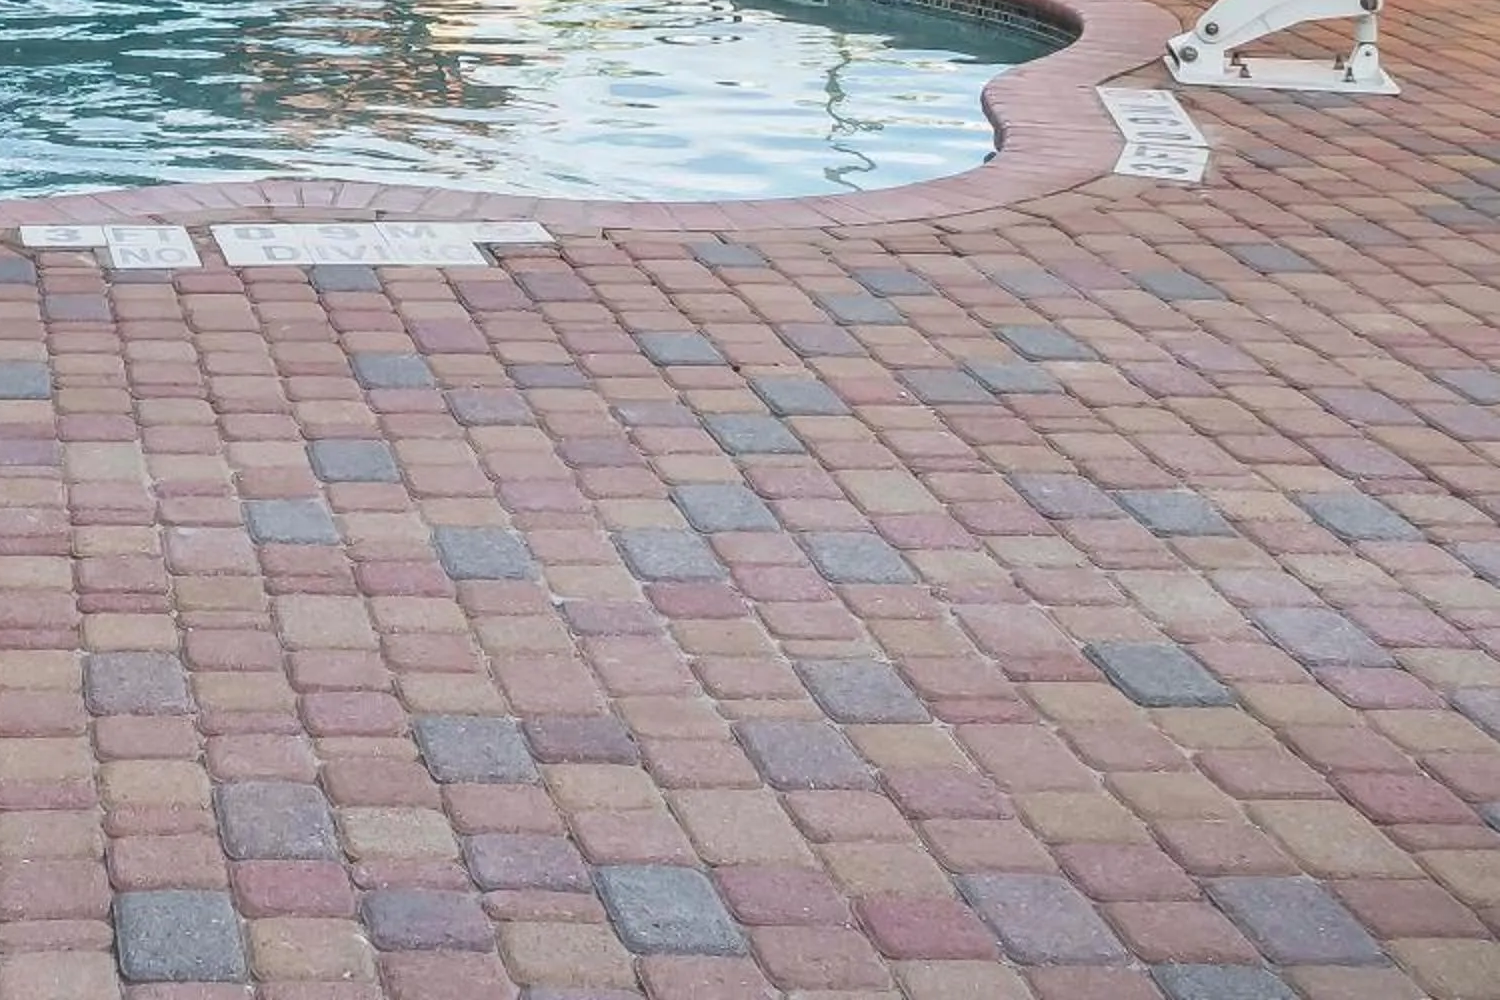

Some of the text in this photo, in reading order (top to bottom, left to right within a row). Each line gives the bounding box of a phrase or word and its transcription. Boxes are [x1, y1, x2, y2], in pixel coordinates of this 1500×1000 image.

[45, 228, 82, 243] 3
[111, 227, 179, 243] FT
[119, 247, 188, 264] NO
